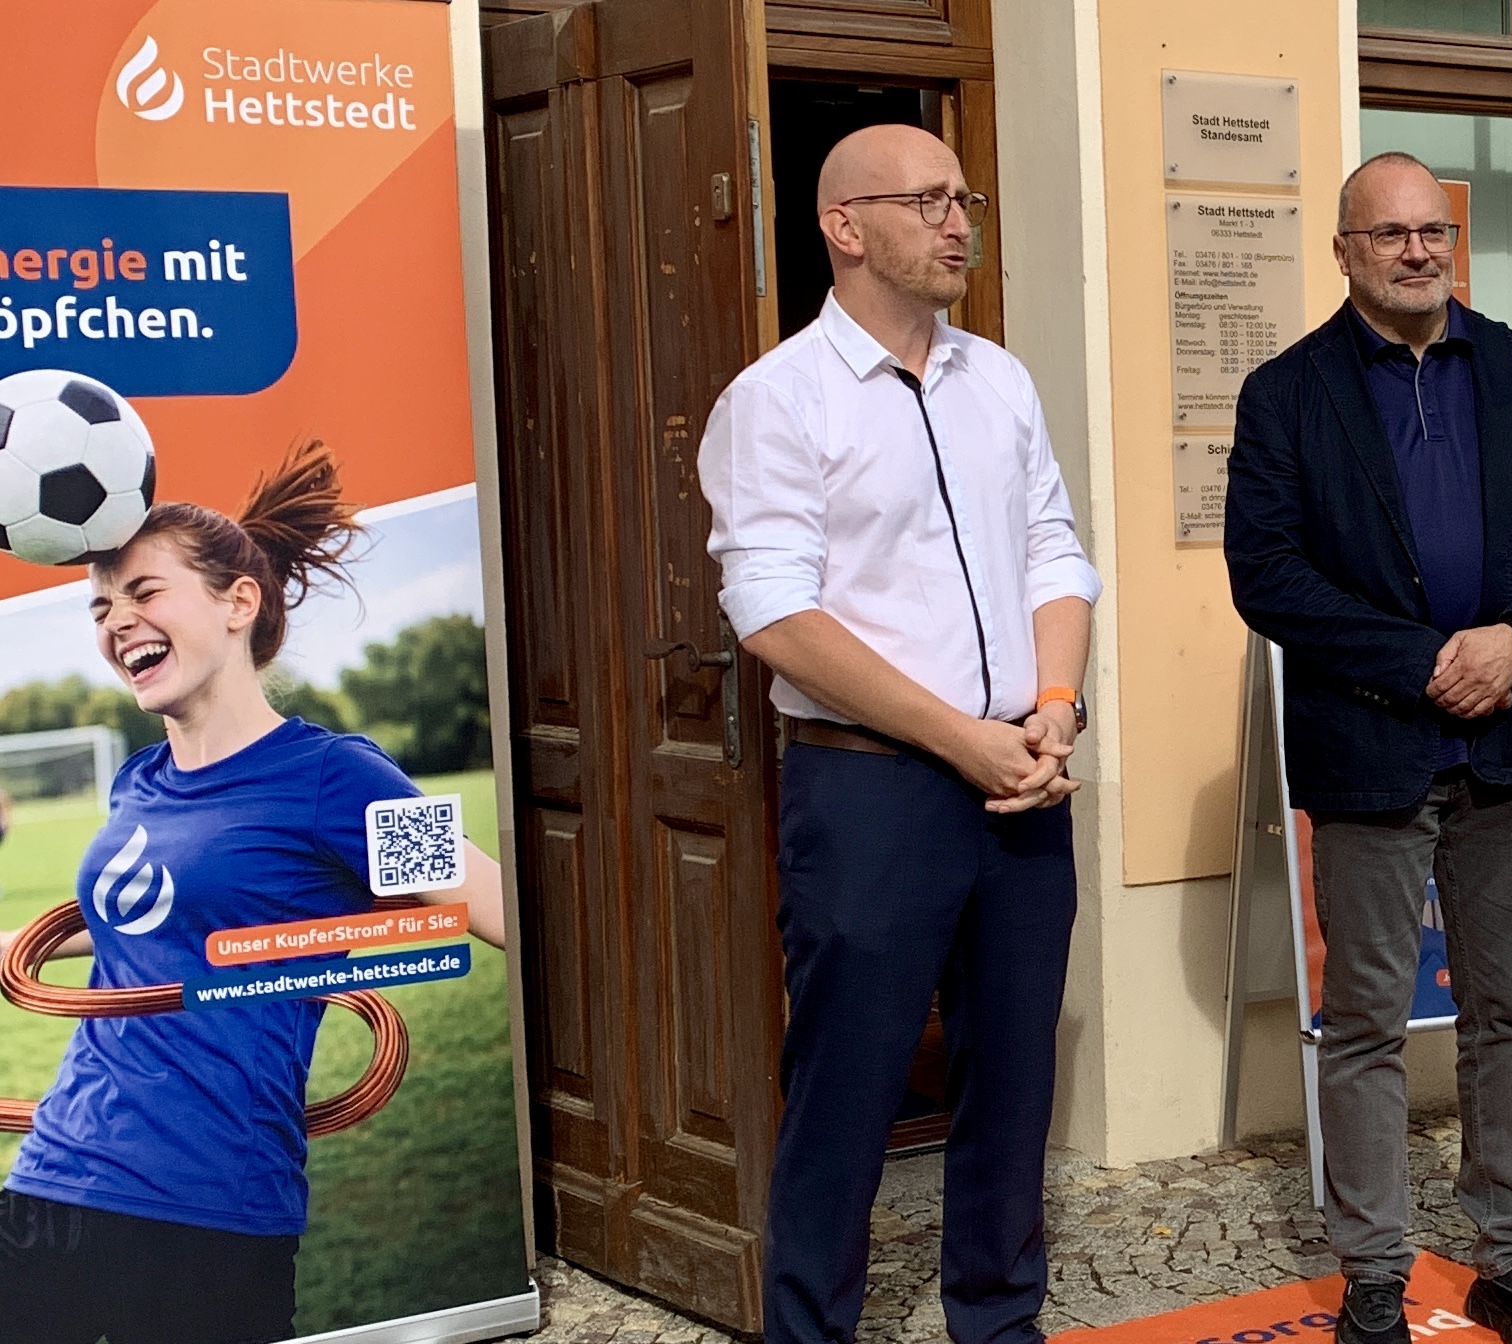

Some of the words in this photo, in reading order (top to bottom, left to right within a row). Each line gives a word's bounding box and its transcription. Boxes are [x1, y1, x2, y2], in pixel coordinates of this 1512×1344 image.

[202, 46, 414, 88] Stadtwerke
[204, 87, 417, 131] Hettstedt
[1192, 114, 1220, 126] Stadt
[1223, 116, 1270, 130] Hettstedt
[1200, 128, 1263, 143] Standesamt
[1198, 205, 1225, 216] Stadt
[1228, 207, 1275, 219] Hettstedt
[0, 237, 147, 290] ergie
[163, 239, 248, 281] mit
[1264, 322, 1277, 330] Uhr
[1266, 330, 1278, 338] Uhr
[1208, 444, 1232, 455] Schi
[216, 936, 271, 956] Unser
[398, 916, 425, 934] für
[427, 914, 459, 930] Sie:
[196, 953, 461, 1002] www.stadtwerke-hettstedt.de
